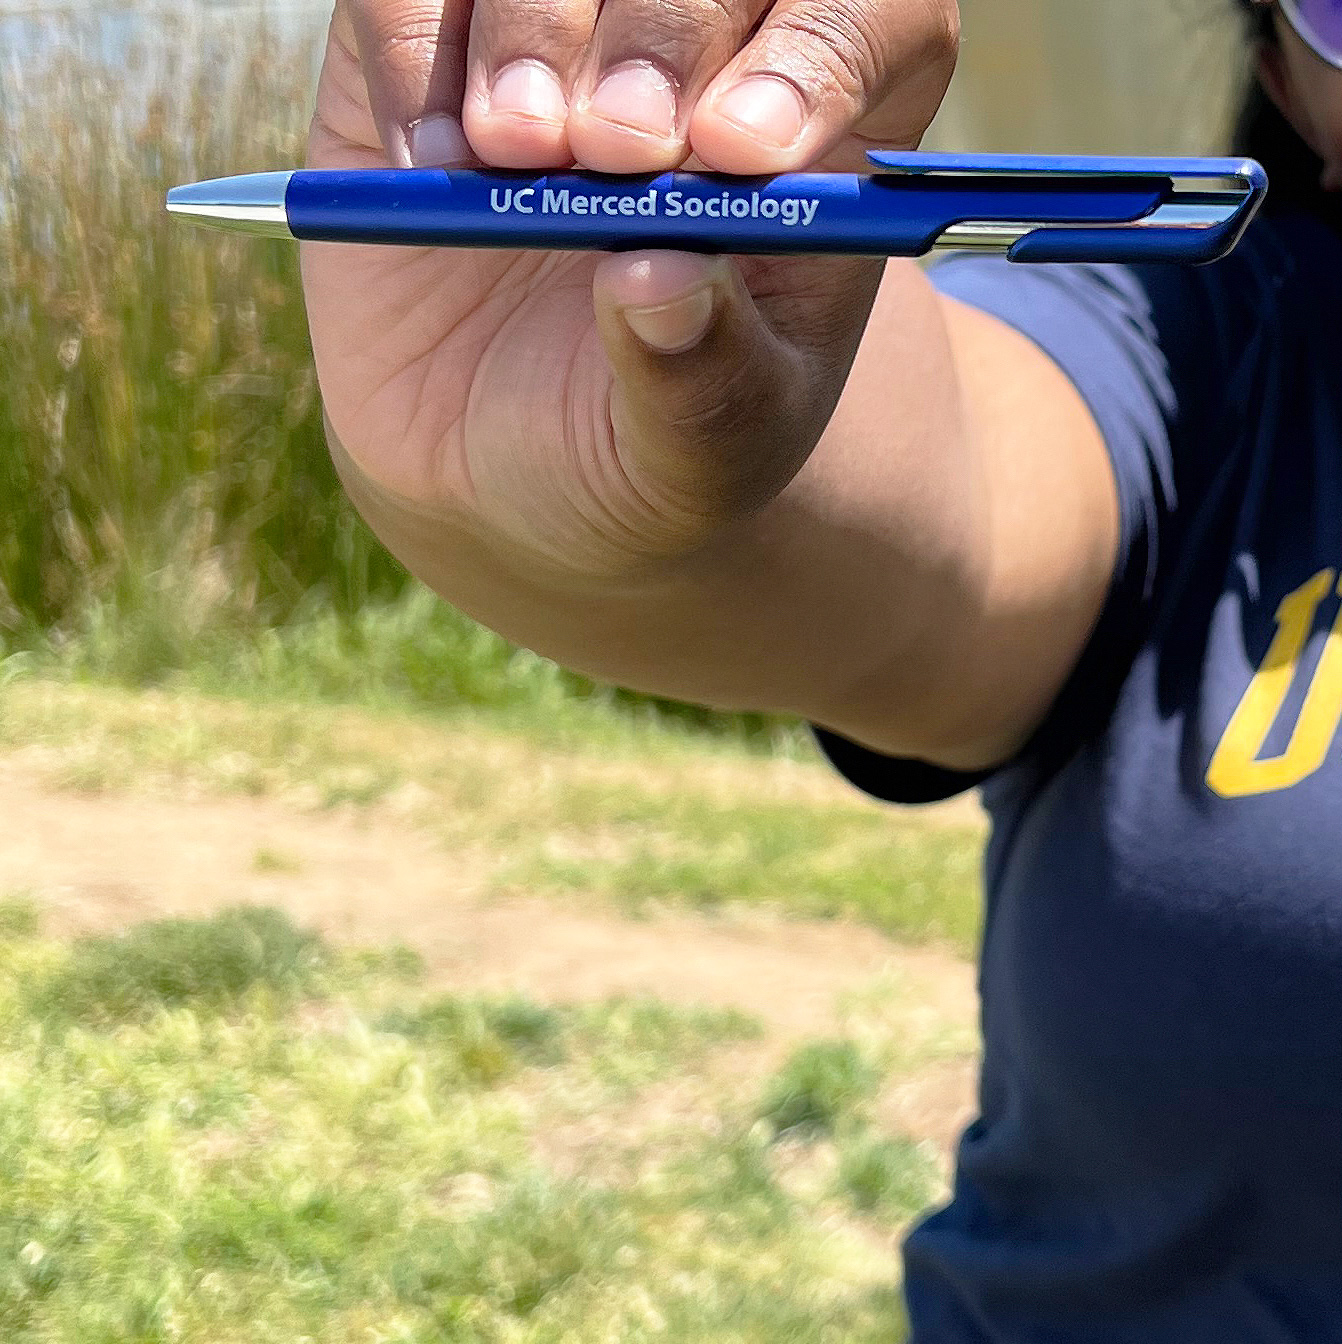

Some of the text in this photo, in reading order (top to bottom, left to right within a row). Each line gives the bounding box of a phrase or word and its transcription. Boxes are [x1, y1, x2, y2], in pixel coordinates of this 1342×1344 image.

[489, 188, 820, 226] UC Merced Sociology
